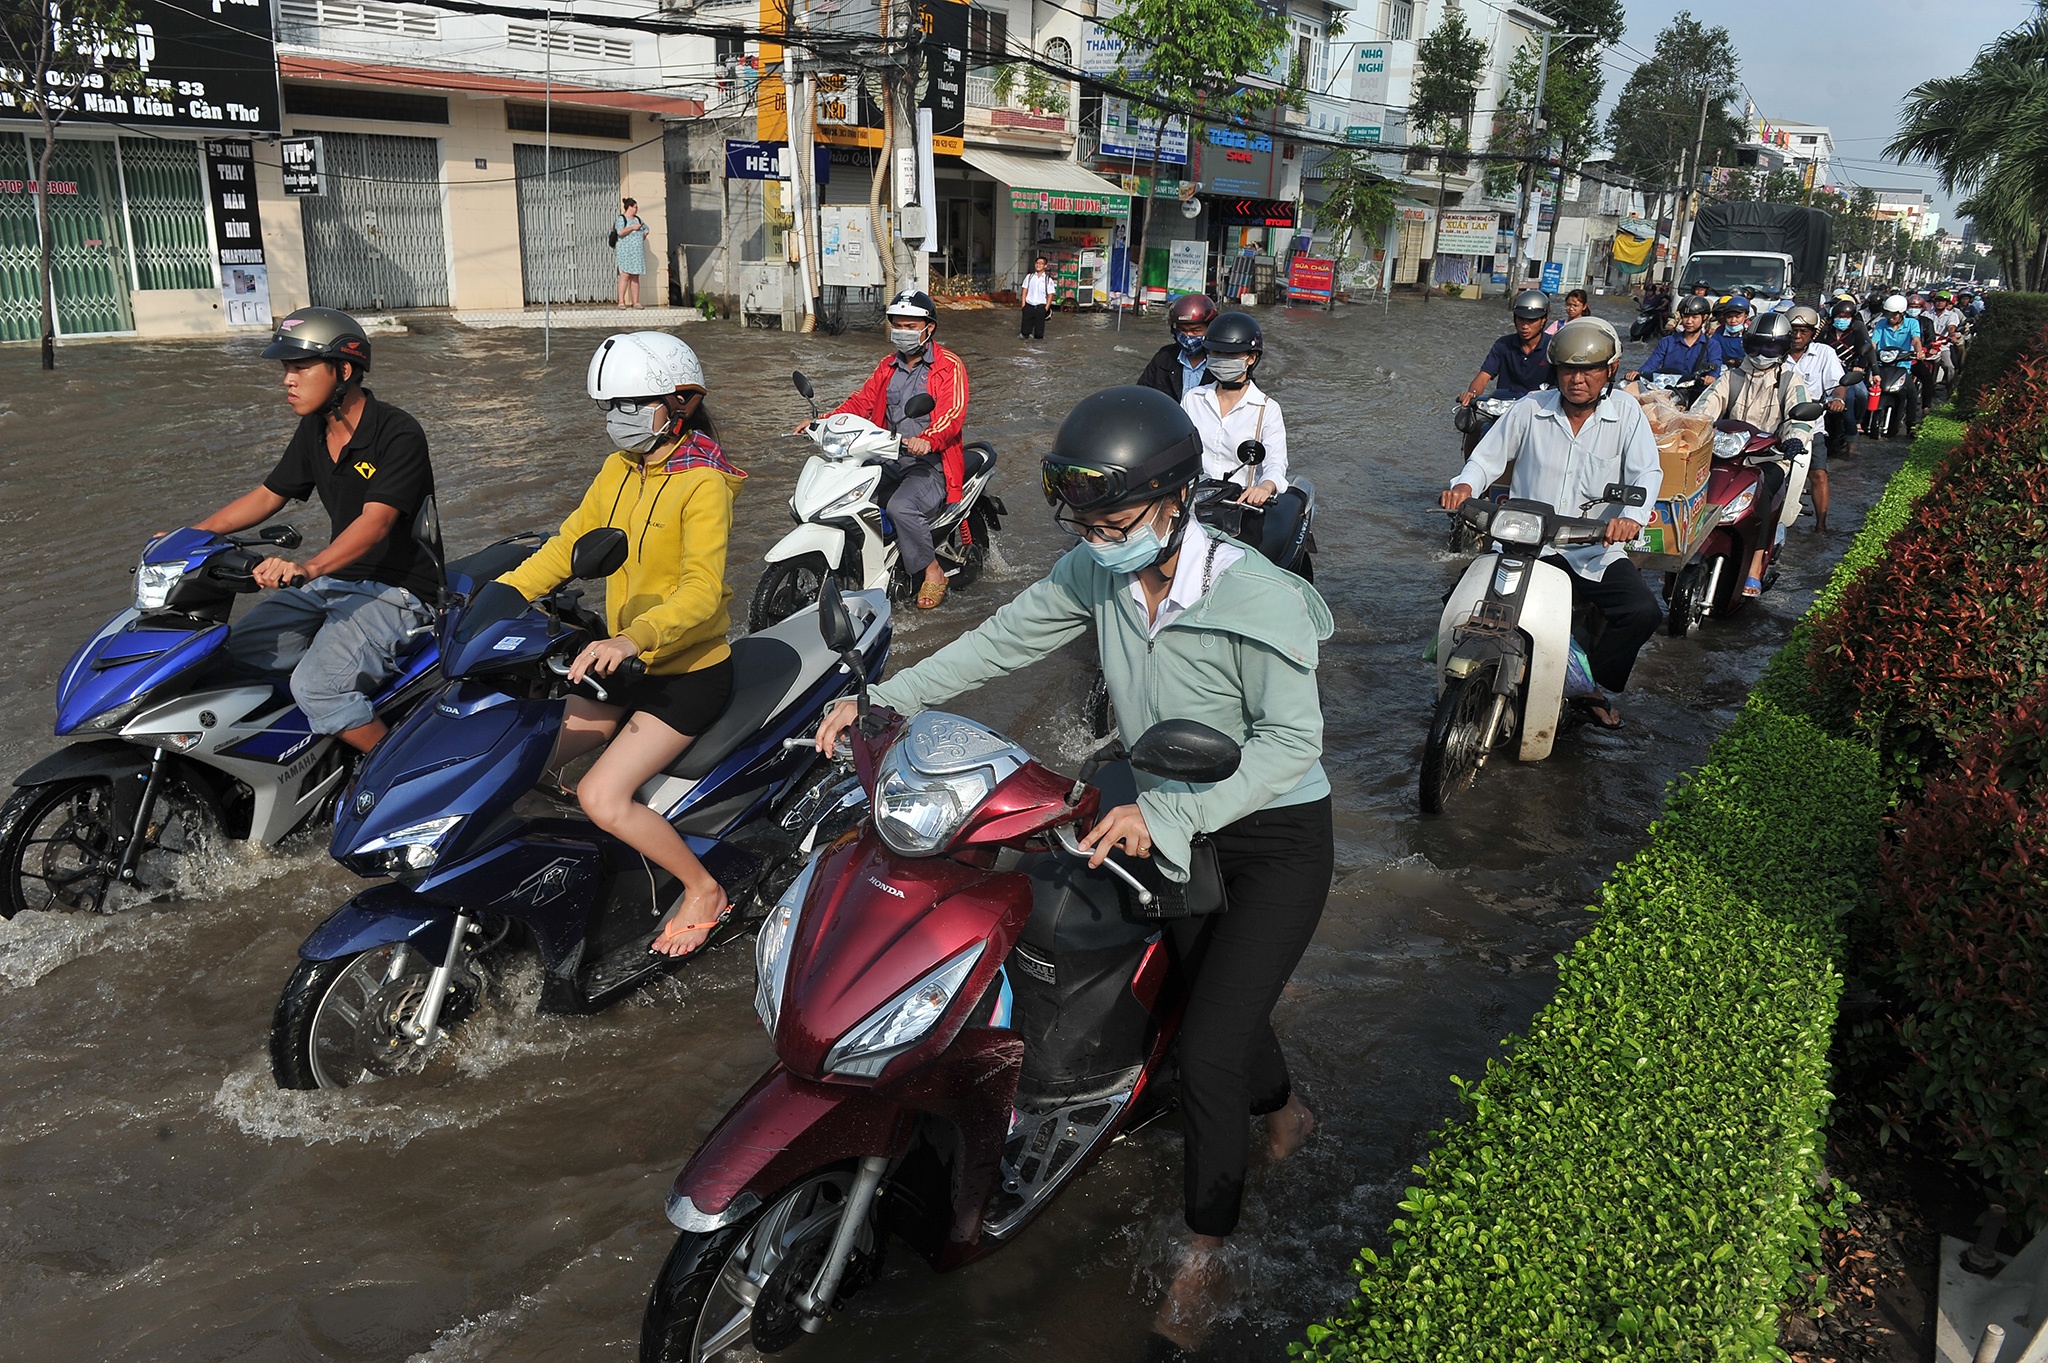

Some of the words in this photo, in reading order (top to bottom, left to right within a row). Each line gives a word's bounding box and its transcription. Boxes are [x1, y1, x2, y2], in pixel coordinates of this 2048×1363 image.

[1086, 40, 1122, 51] THANH
[1361, 48, 1383, 59] NHÀ
[1358, 60, 1384, 73] NGHỈ
[178, 81, 205, 97] 33
[84, 93, 128, 113] Ninh
[133, 95, 174, 117] Kiều
[189, 99, 223, 119] Cần
[226, 103, 260, 122] Thơ
[225, 142, 250, 158] KÍNH
[217, 164, 244, 180] THAY
[223, 189, 246, 209] MÀN
[225, 217, 251, 238] HÌNH
[1265, 218, 1292, 227] STORE
[1446, 221, 1468, 229] XUÂN
[1471, 222, 1489, 230] LAN
[220, 249, 263, 263] SMARTPHONE
[277, 733, 314, 763] 150
[277, 752, 318, 785] YAMAHA
[868, 875, 906, 899] HONDA
